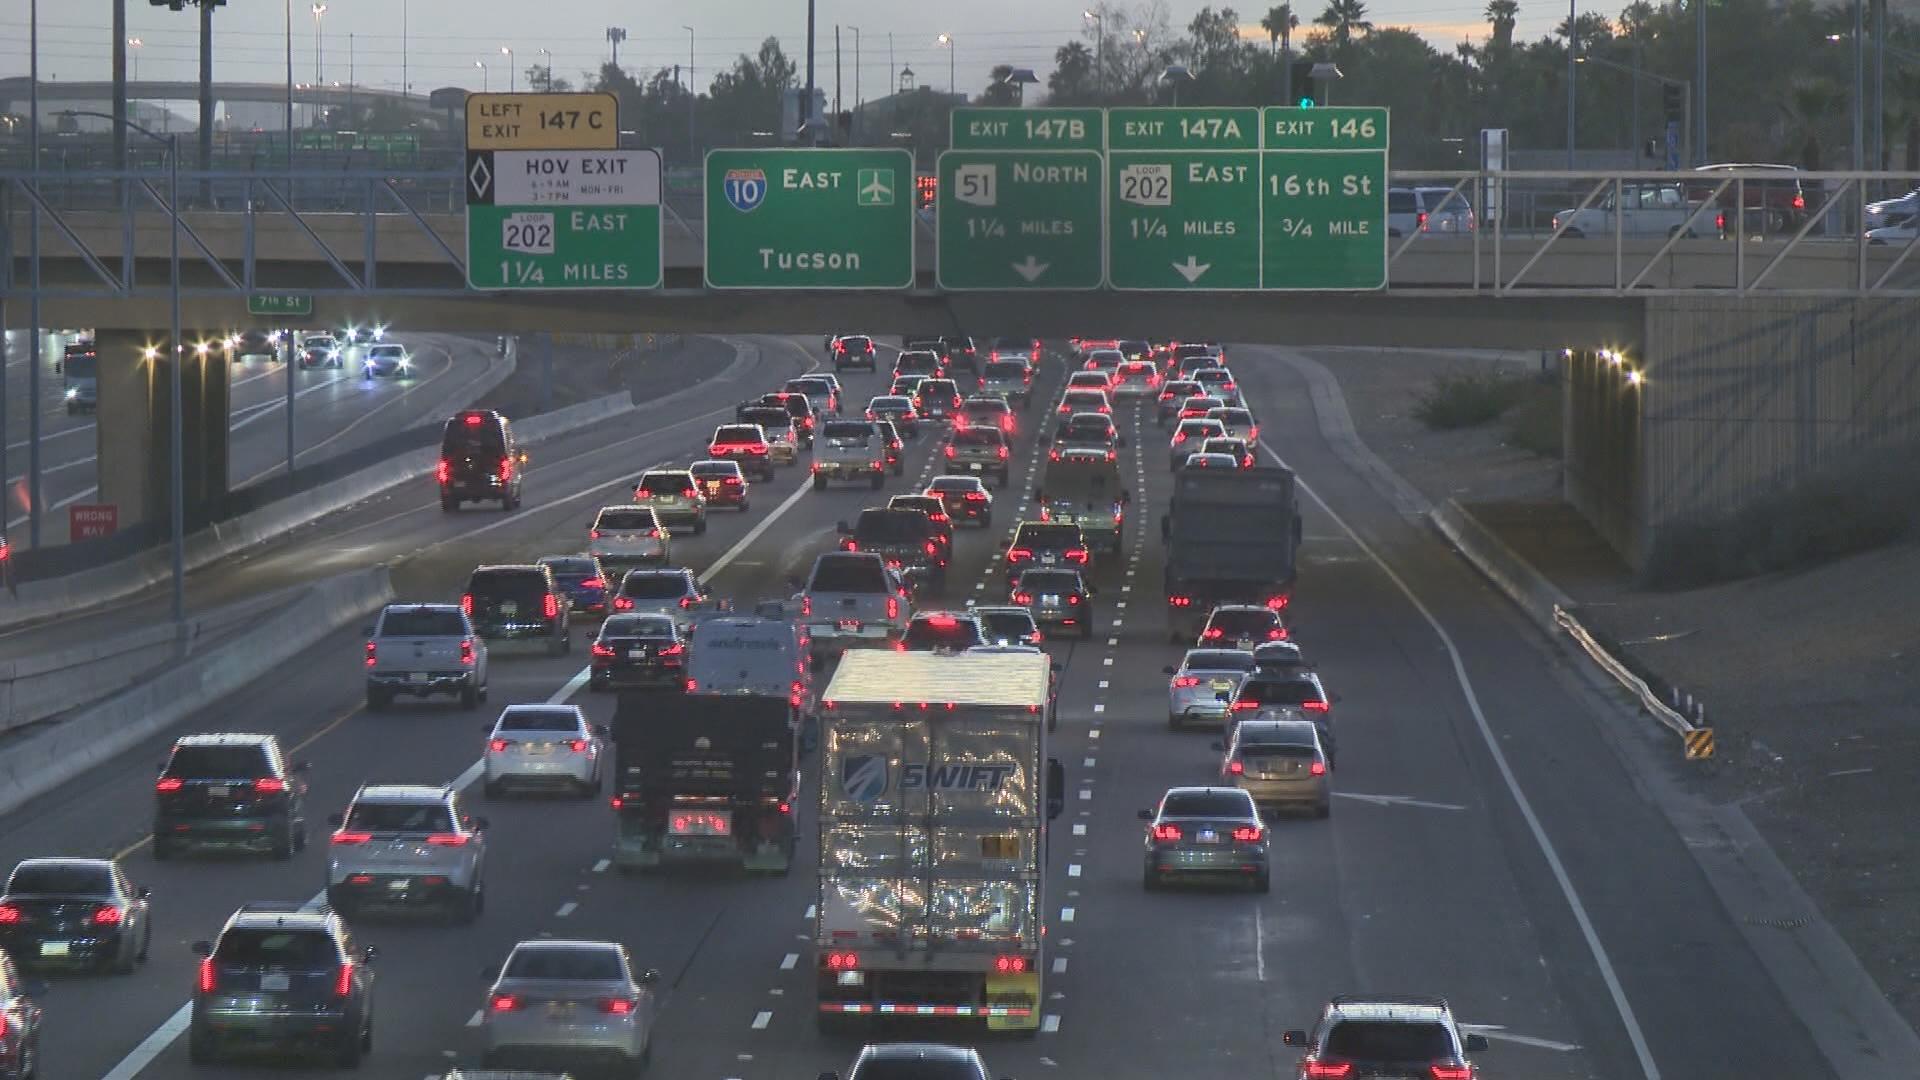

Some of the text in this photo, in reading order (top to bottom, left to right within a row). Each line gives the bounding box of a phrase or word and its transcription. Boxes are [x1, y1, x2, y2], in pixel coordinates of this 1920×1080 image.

[480, 103, 523, 117] LEFT
[539, 111, 603, 129] 147 C
[969, 119, 1085, 139] EXIT 147B
[1125, 118, 1241, 139] EXIT 147A
[1276, 118, 1376, 138] EXIT 146
[482, 125, 521, 138] EXIT
[526, 159, 628, 175] HOV EXIT
[1013, 163, 1088, 182] NORTH
[1136, 166, 1161, 174] LOOP
[1189, 163, 1248, 182] EAST
[783, 169, 842, 188] EAST
[963, 174, 989, 197] 51
[1125, 176, 1168, 199] 202
[1270, 174, 1371, 196] 16th St
[732, 180, 759, 204] 10
[520, 215, 545, 223] LOOP
[571, 212, 628, 231] EAST
[1021, 221, 1074, 234] MILES
[1184, 221, 1236, 234] MILES
[1329, 221, 1369, 234] MILE
[506, 225, 551, 247] 202
[759, 248, 861, 269] Tucson
[564, 264, 629, 280] MILES
[286, 296, 300, 306] St
[75, 511, 112, 521] WRONG
[82, 527, 105, 537] WAY
[899, 763, 1017, 791] SWIFT
